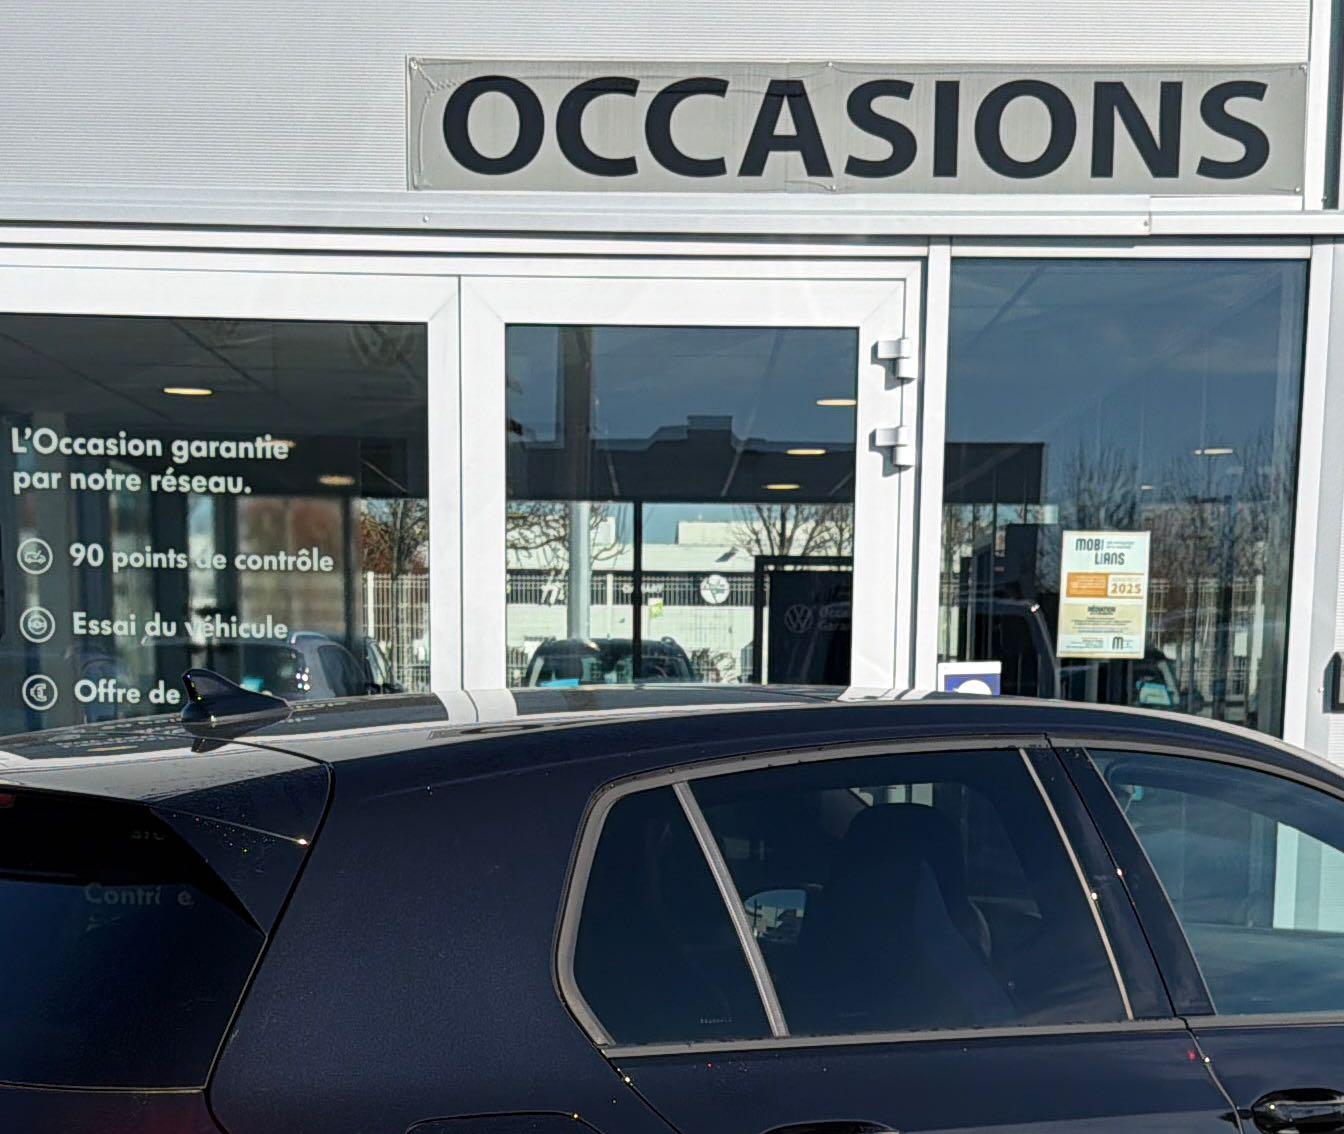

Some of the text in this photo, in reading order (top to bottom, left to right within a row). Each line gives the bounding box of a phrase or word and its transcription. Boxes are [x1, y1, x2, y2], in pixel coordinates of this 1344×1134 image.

[442, 75, 1270, 179] OCCASIONS
[11, 427, 289, 464] L'Occasion garantie
[13, 467, 252, 494] par notre réseau.
[69, 543, 335, 573] 90 points de contrôle
[1075, 538, 1104, 551] MOBI
[1111, 583, 1142, 595] 2025
[72, 611, 289, 640] Essai du véhicule
[74, 678, 181, 704] Offre de
